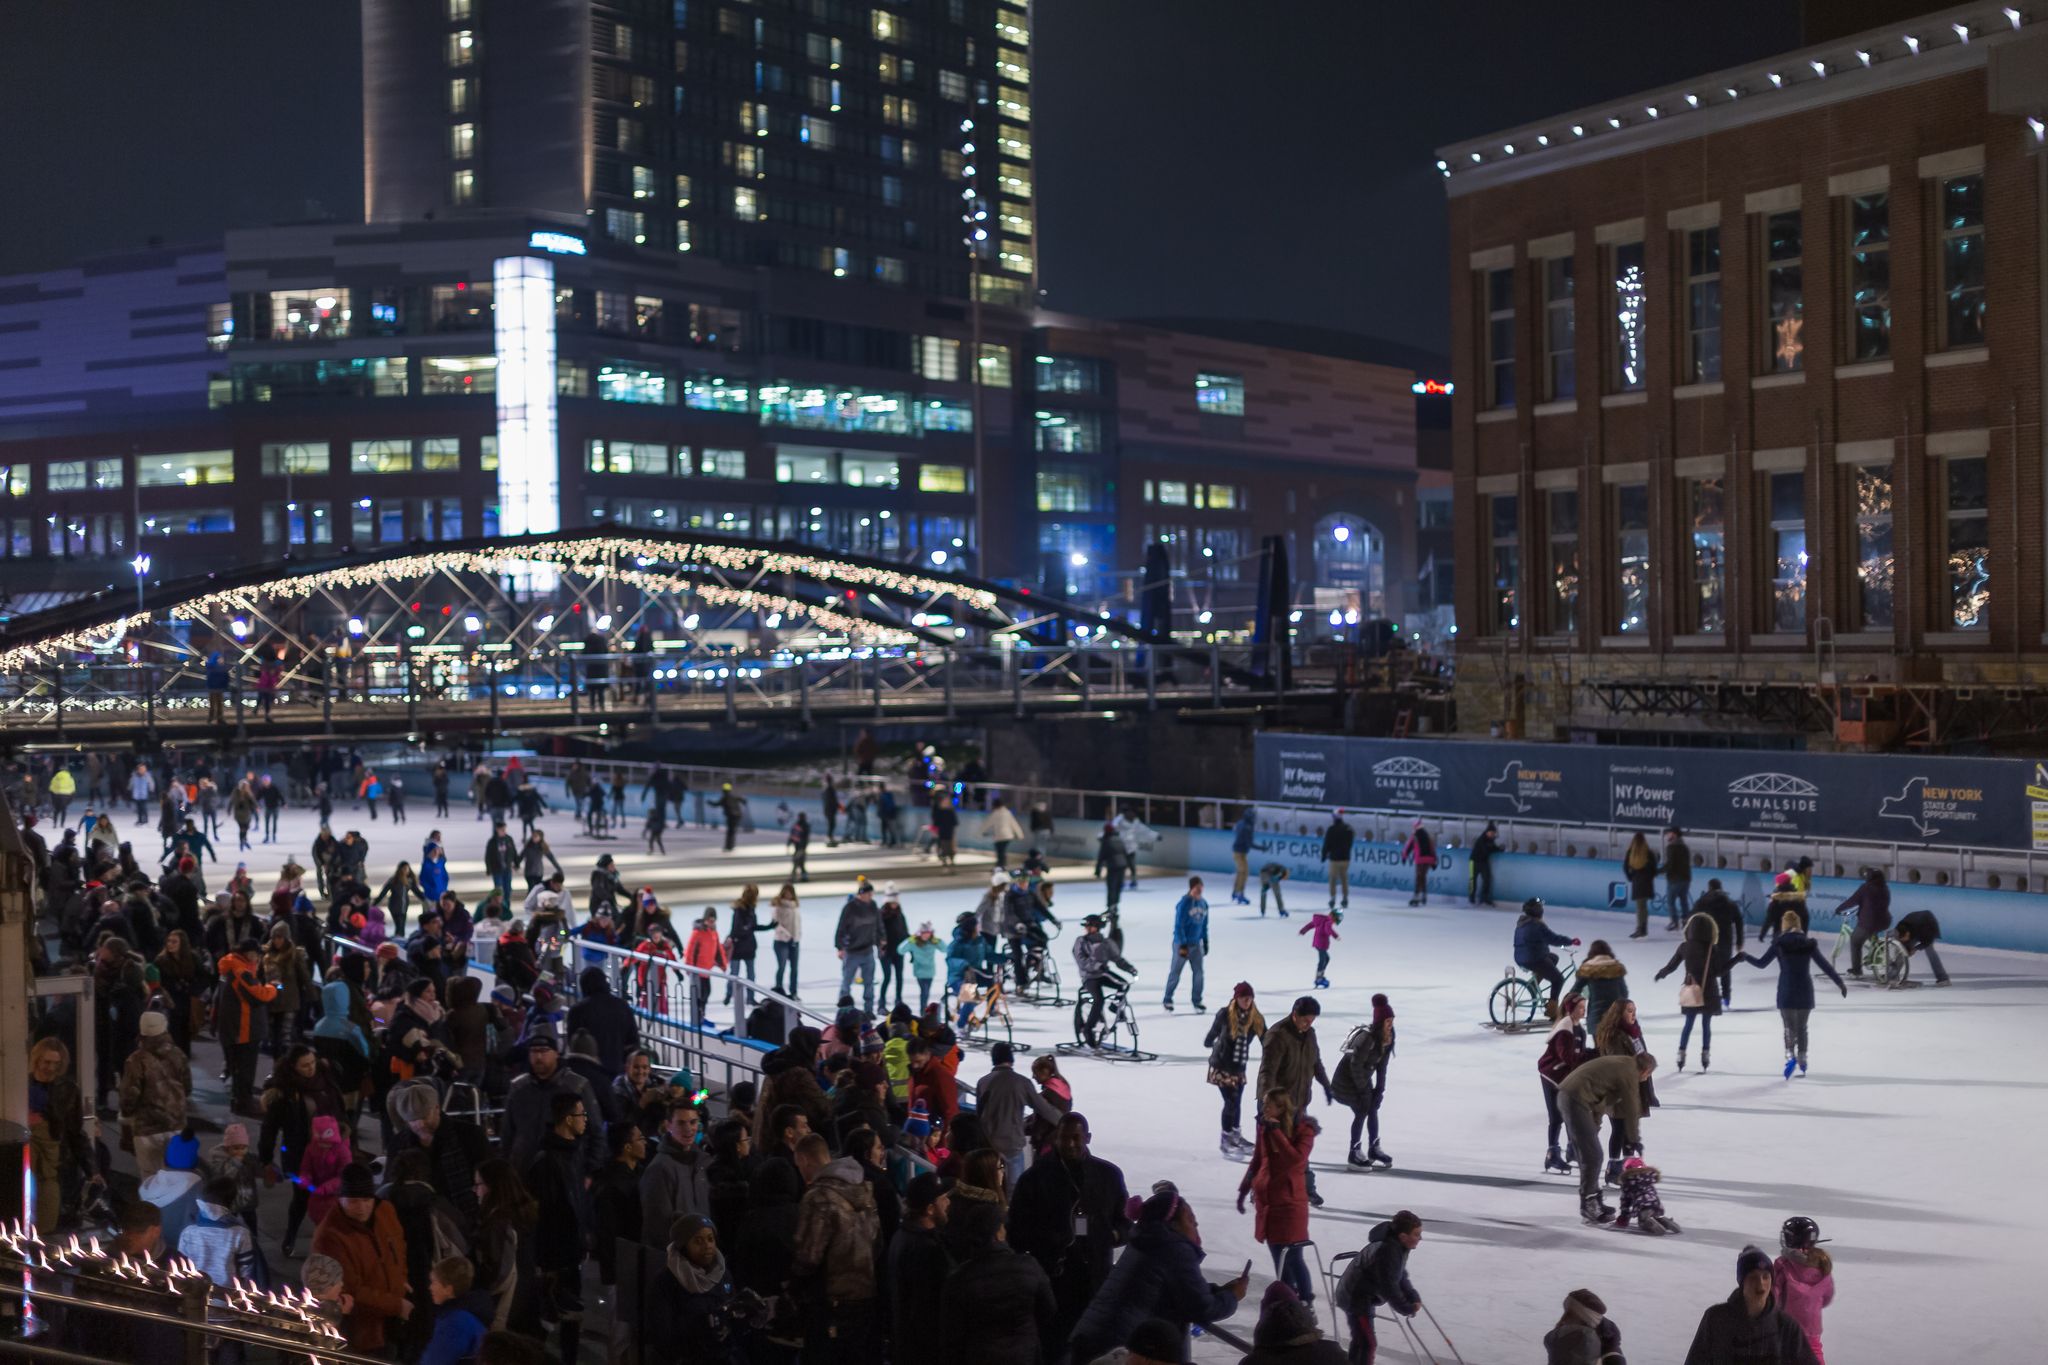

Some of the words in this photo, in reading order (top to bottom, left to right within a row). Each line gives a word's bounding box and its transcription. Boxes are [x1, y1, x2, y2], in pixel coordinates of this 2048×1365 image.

[1297, 767, 1326, 783] Power
[1517, 769, 1537, 781] NEW
[1539, 770, 1562, 782] YORK
[1375, 777, 1440, 791] CANALSIDE
[1283, 783, 1327, 802] Authority
[1615, 784, 1633, 799] NY
[1635, 785, 1675, 801] Power
[1922, 787, 1948, 799] NEW
[1950, 788, 1983, 801] YORK
[1731, 796, 1817, 812] CANALSIDE
[1922, 801, 1945, 810] STATE
[1946, 801, 1958, 811] OF
[1615, 801, 1676, 824] Authority
[1276, 840, 1286, 855] P
